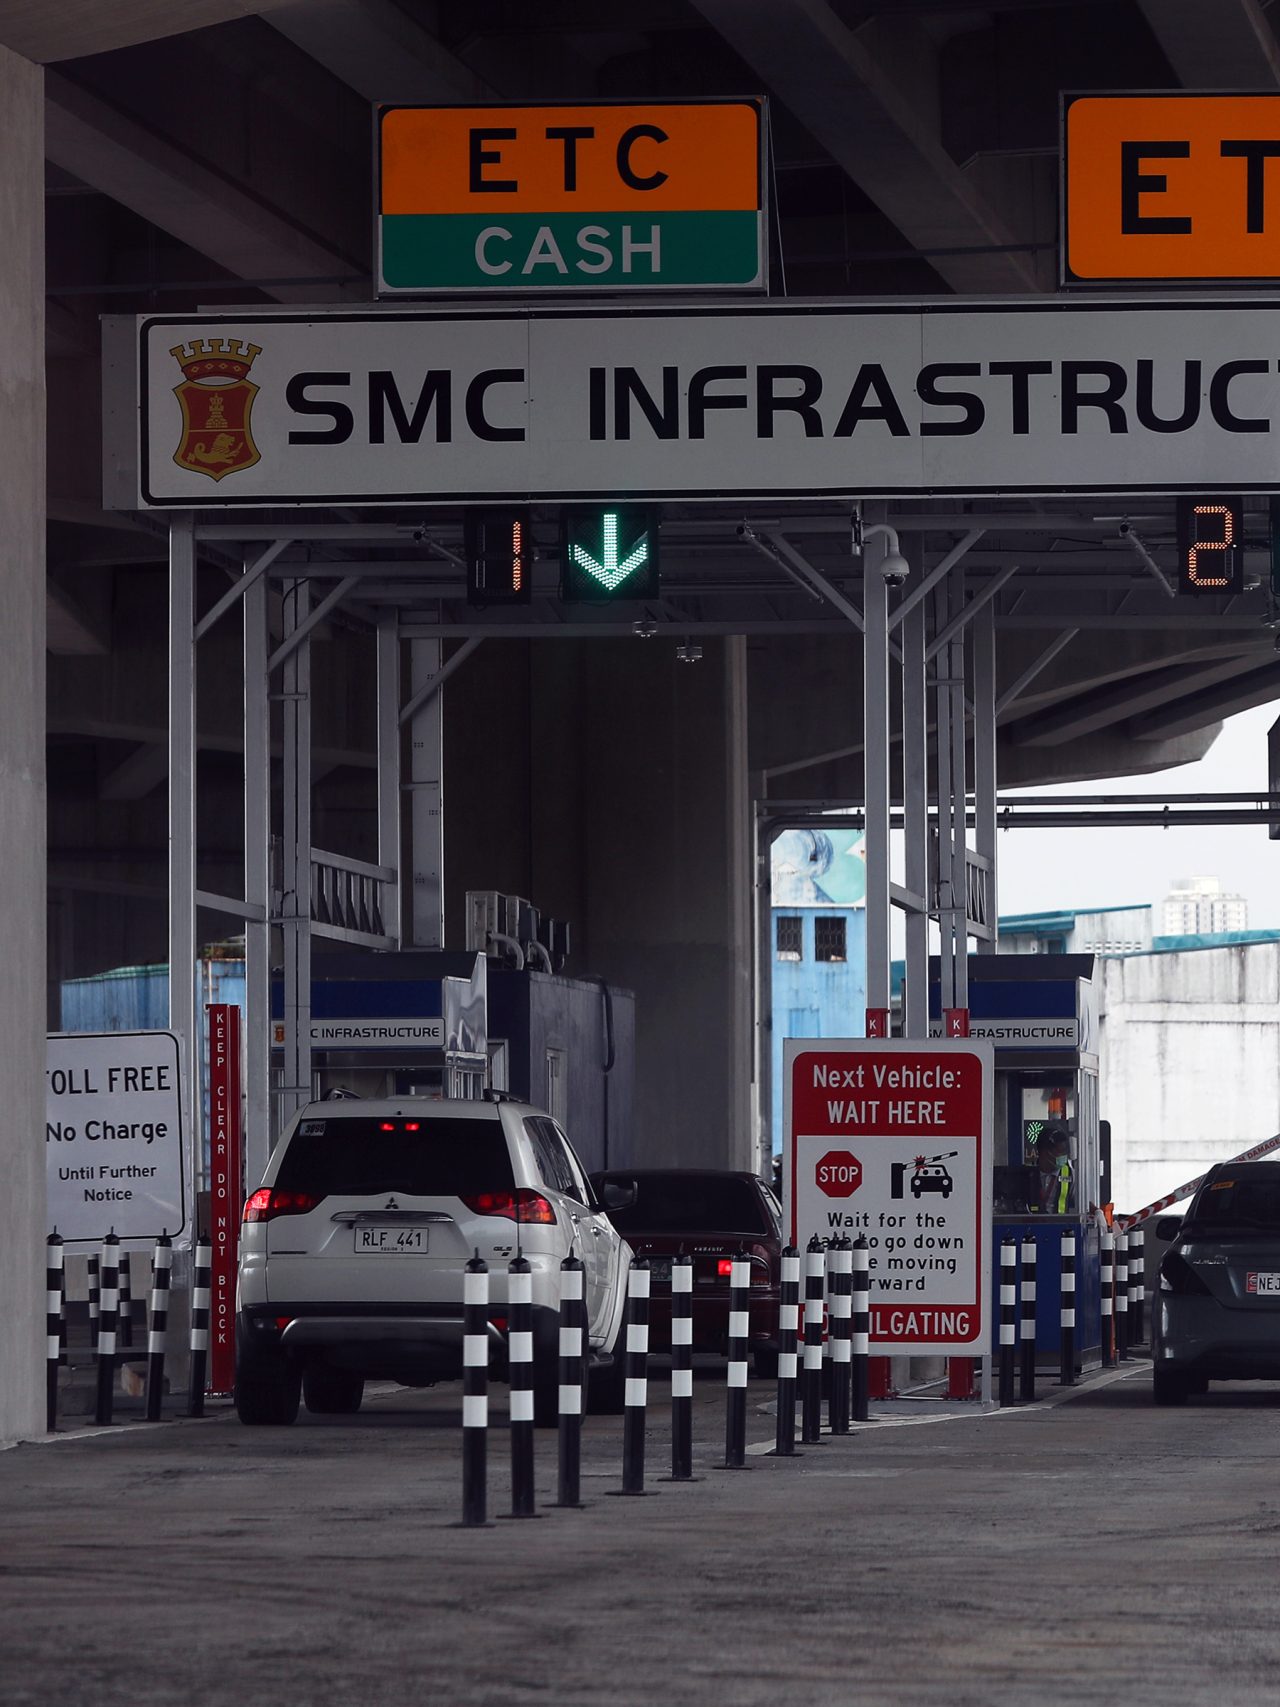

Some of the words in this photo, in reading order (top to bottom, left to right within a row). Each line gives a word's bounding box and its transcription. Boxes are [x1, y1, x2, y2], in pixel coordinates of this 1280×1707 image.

[468, 124, 669, 193] ETC
[474, 224, 662, 276] CASH
[285, 368, 527, 446] SMC
[1187, 505, 1234, 586] 2
[216, 1013, 225, 1067] KEEP
[321, 1027, 440, 1039] INFRASTRUCTURE
[969, 1027, 1074, 1038] FRASTRUCTURE
[46, 1068, 98, 1095] OLL
[108, 1065, 171, 1093] FREE
[813, 1064, 865, 1088] Next
[872, 1064, 962, 1089] Vehicle:
[217, 1085, 226, 1155] CLEAR
[827, 1101, 880, 1124] WAIT
[888, 1101, 946, 1124] HERE
[46, 1122, 76, 1142] No
[85, 1120, 168, 1144] Charge
[1247, 1138, 1280, 1159] DAMAGE
[59, 1166, 94, 1180] Until
[100, 1165, 157, 1179] Further
[819, 1166, 859, 1183] STOP
[84, 1187, 133, 1202] Notice
[217, 1173, 226, 1199] DO
[828, 1211, 870, 1228] Wait
[878, 1212, 907, 1228] for
[916, 1212, 946, 1228] the
[218, 1216, 227, 1257] NOT
[362, 1232, 388, 1246] RLF
[397, 1232, 421, 1247] 441
[885, 1236, 906, 1252] go
[914, 1233, 964, 1249] down
[887, 1255, 957, 1274] moving
[868, 1276, 926, 1290] rward
[218, 1275, 227, 1344] BLOCK
[868, 1311, 970, 1335] ILGATING
